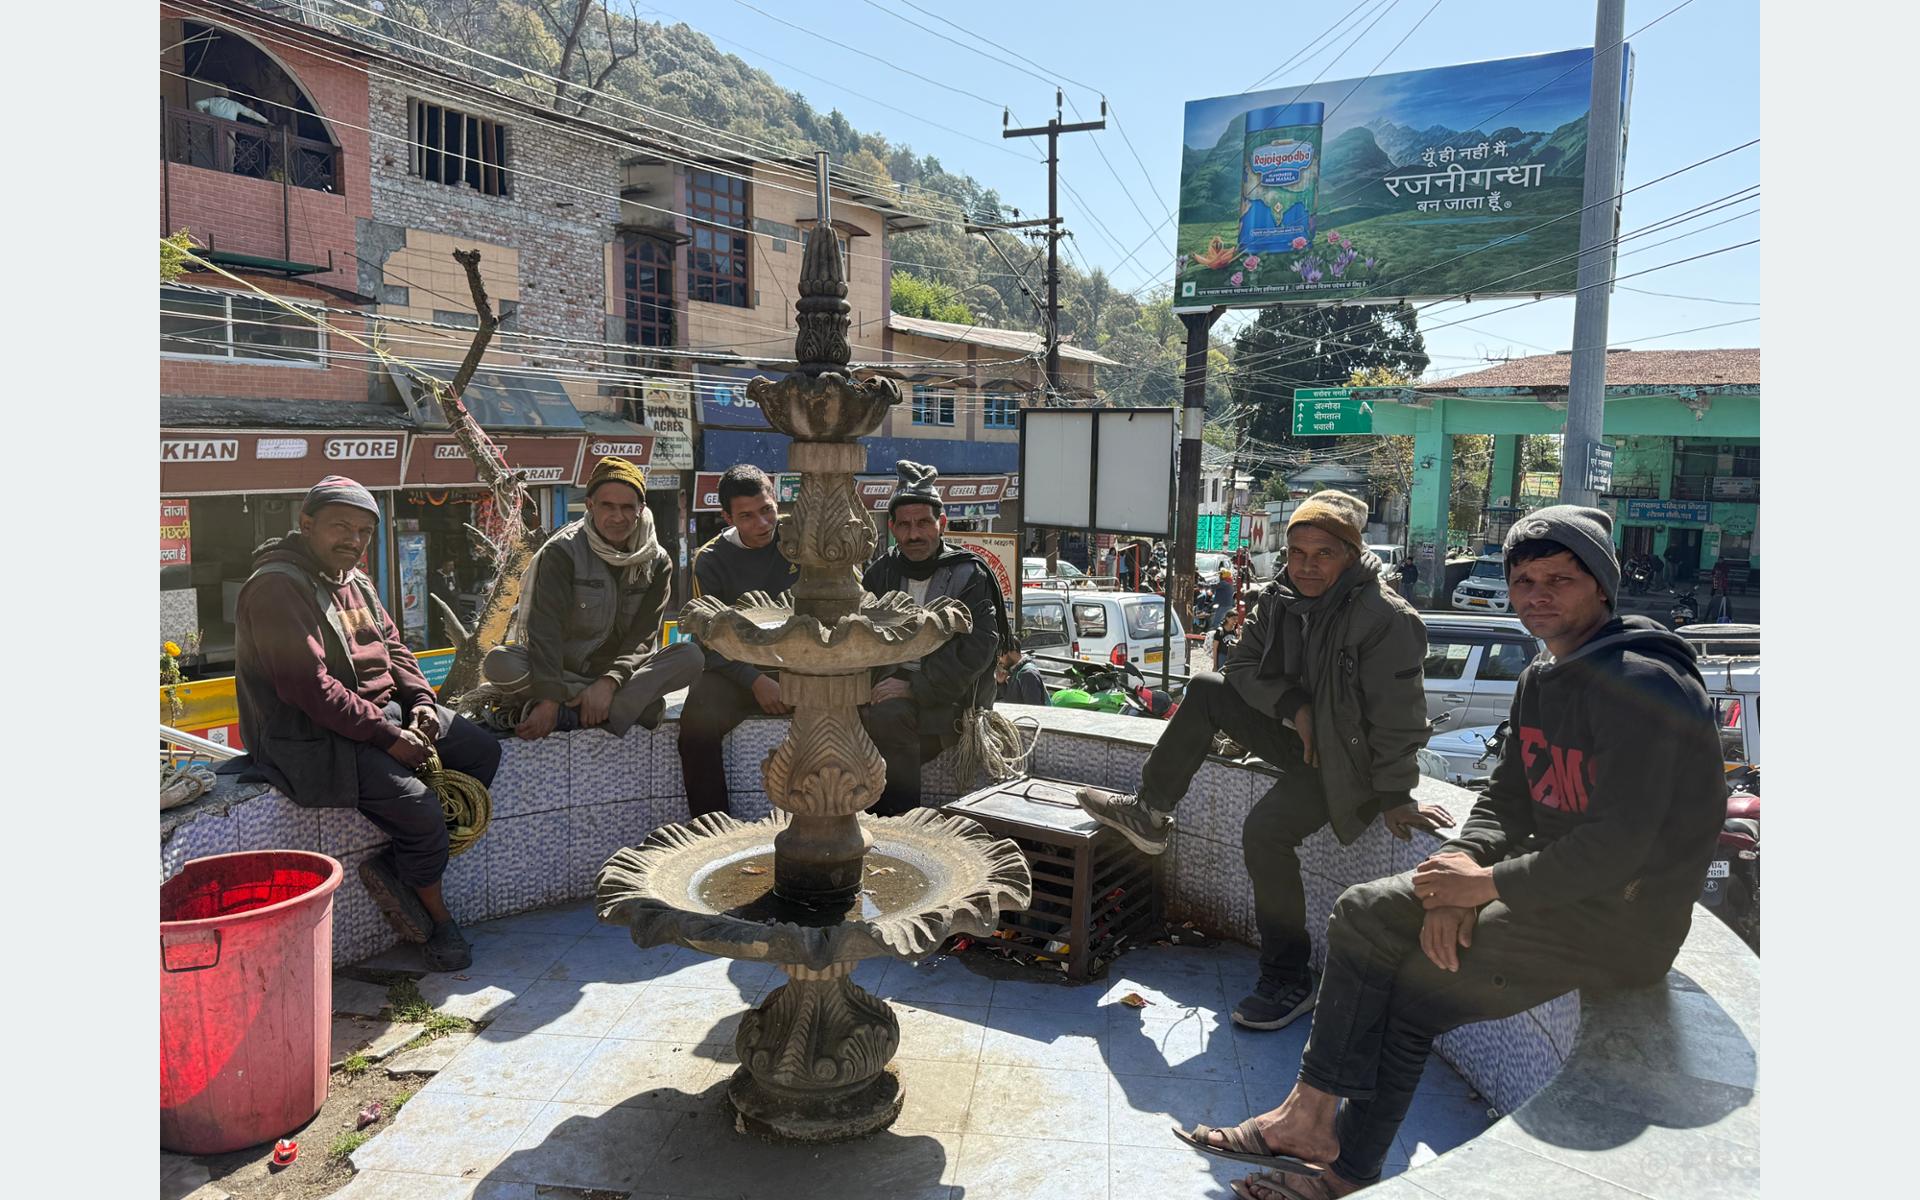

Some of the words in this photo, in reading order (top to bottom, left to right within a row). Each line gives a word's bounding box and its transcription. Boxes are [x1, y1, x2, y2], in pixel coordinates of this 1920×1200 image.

[1253, 150, 1310, 166] Rajnigandha
[1422, 146, 1438, 167] यूँ
[1439, 146, 1456, 163] ही
[1459, 142, 1490, 160] नहीं
[1383, 163, 1546, 198] रजनीगन्धा
[1416, 200, 1441, 213] बन
[1443, 196, 1485, 211] जाता
[654, 421, 684, 432] ACRES
[162, 442, 236, 459] KHAN
[328, 441, 396, 457] STORE
[594, 444, 641, 454] SONKAR
[951, 486, 977, 495] GENERAL
[981, 485, 998, 494] STORE
[163, 505, 187, 517] ताजा
[160, 520, 191, 539] मछली
[180, 544, 186, 560] है
